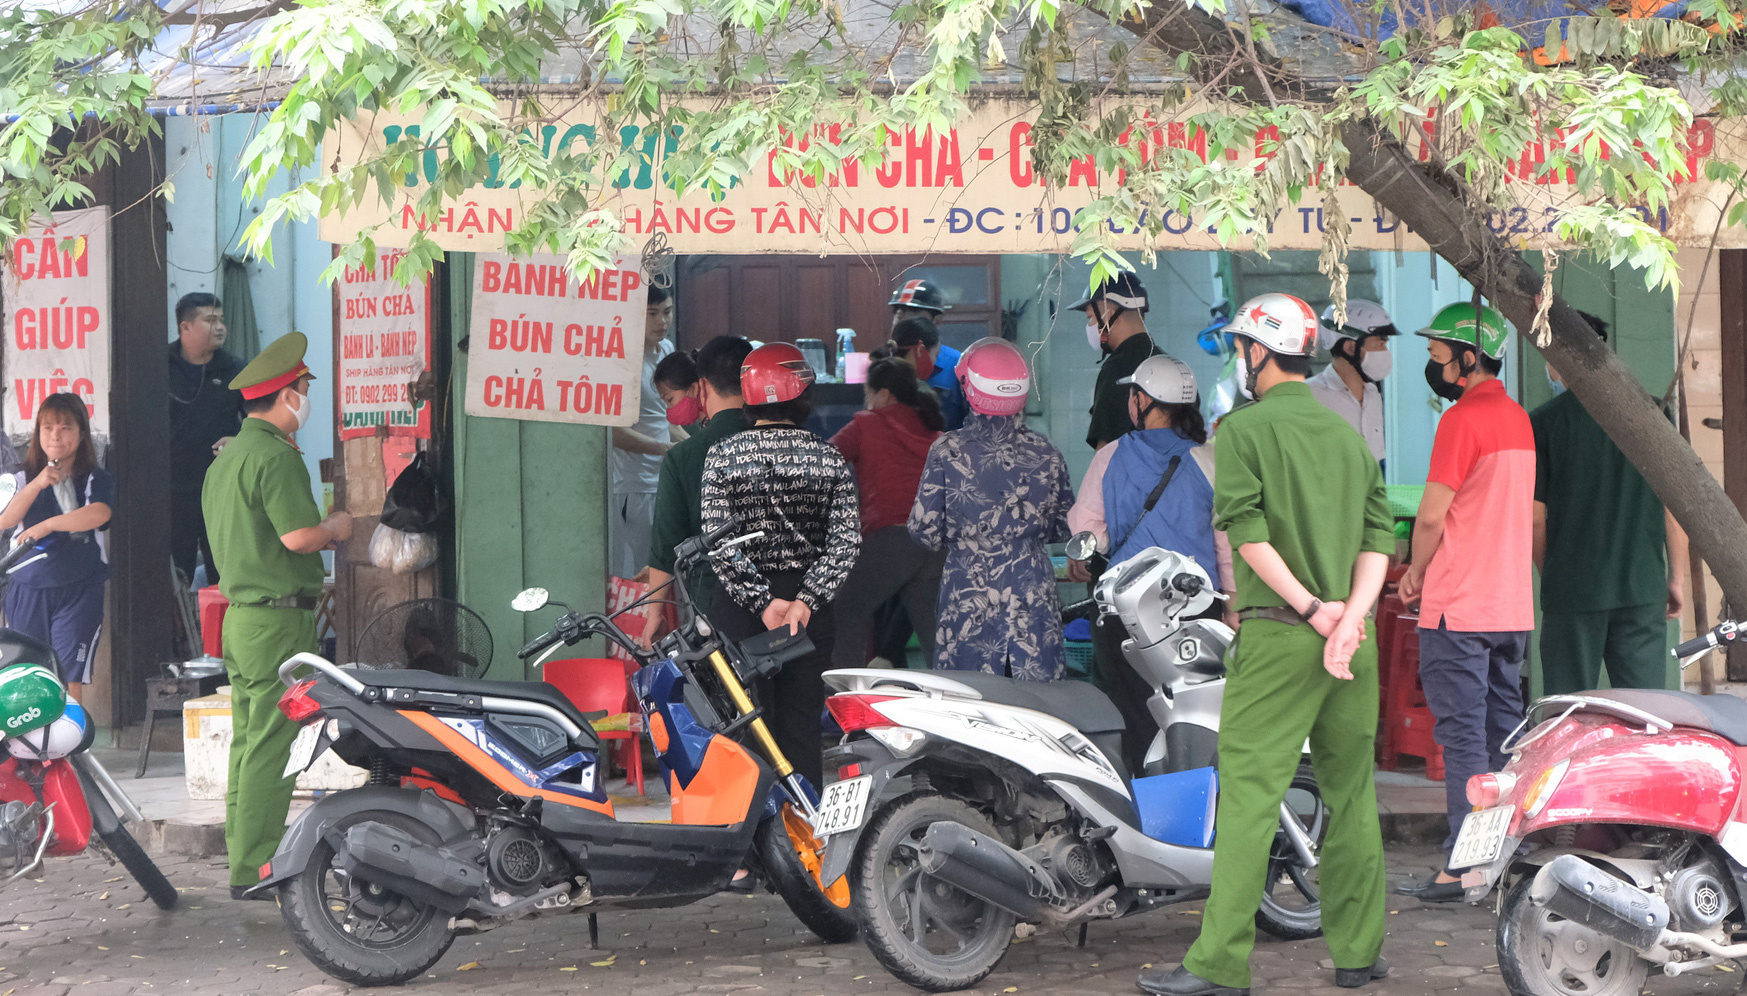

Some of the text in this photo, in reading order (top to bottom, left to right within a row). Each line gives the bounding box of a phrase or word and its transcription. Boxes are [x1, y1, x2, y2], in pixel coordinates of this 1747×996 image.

[402, 201, 513, 239] NHẬN
[620, 200, 736, 234] HÀNG
[751, 201, 823, 234] TÂN
[839, 206, 909, 234] NƠI
[346, 285, 416, 319] BÚN CHẢ
[14, 297, 100, 351] GIÚP
[488, 313, 626, 359] BÚN CHẢ
[344, 326, 364, 360] BÁNH
[345, 368, 362, 378] SHIP
[385, 364, 399, 376] TÂN
[360, 384, 380, 404] 0902
[382, 383, 398, 402] 299
[483, 367, 623, 416] CHẢ TÔM
[7, 706, 41, 728] Grab
[826, 780, 861, 808] 36-B1
[817, 803, 860, 834] 748.91
